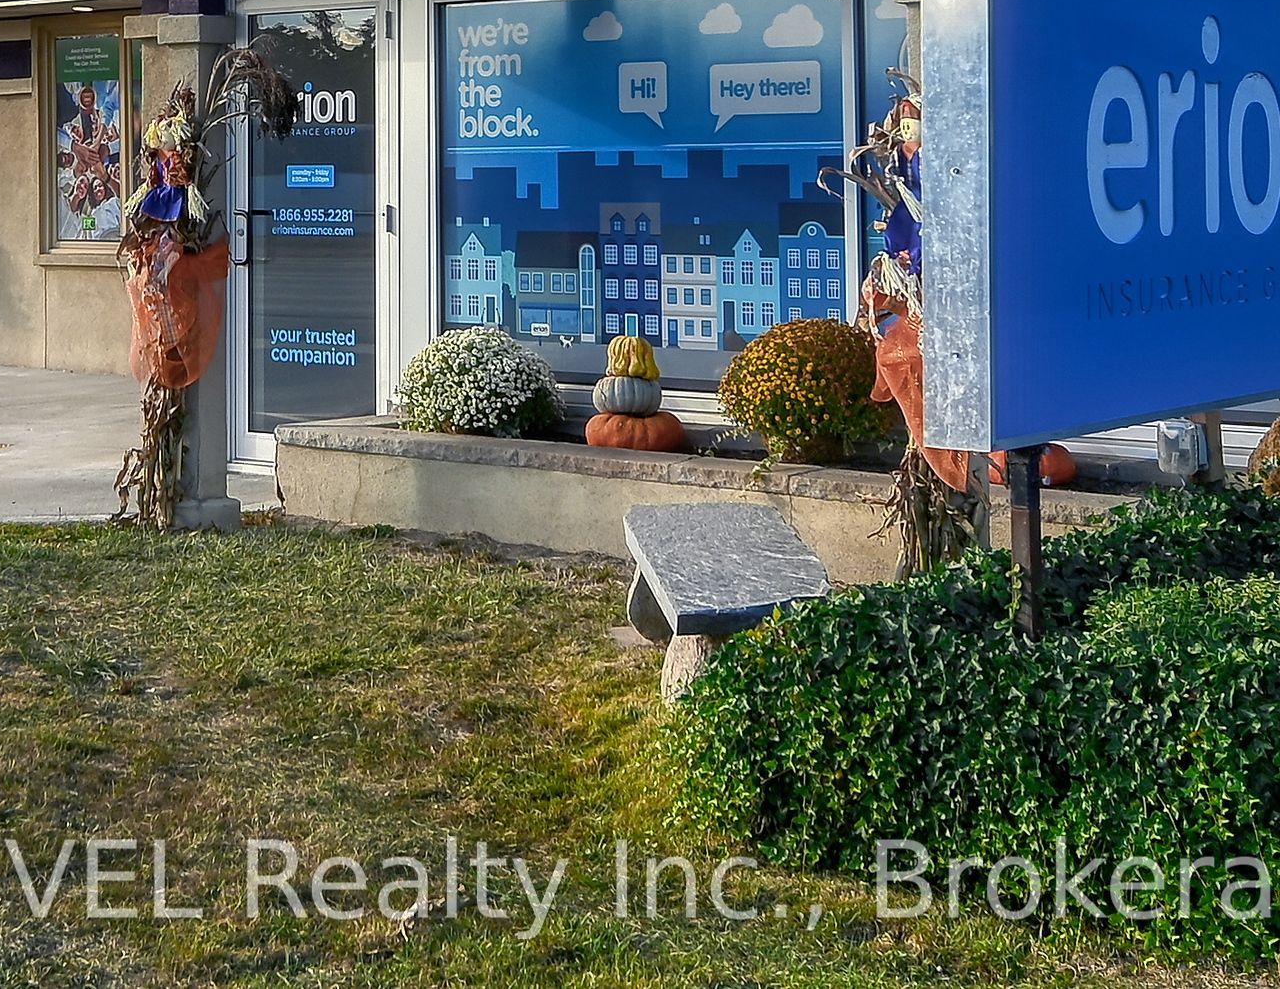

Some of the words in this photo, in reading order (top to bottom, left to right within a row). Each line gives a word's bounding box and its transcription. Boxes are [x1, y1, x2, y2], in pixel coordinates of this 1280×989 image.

[457, 17, 529, 47] we're
[458, 48, 522, 77] from
[458, 78, 502, 107] the
[630, 77, 657, 99] Hi!
[720, 79, 755, 101] Hey
[758, 77, 811, 96] there!
[292, 81, 356, 123] ion
[323, 127, 356, 136] GROUP
[459, 107, 539, 138] block.
[271, 208, 353, 222] 1.866.955.2281
[271, 223, 354, 236] erioninsurance.com
[1087, 267, 1249, 321] INSURANCE
[270, 328, 302, 345] your
[305, 327, 356, 346] trusted
[270, 347, 355, 367] companion
